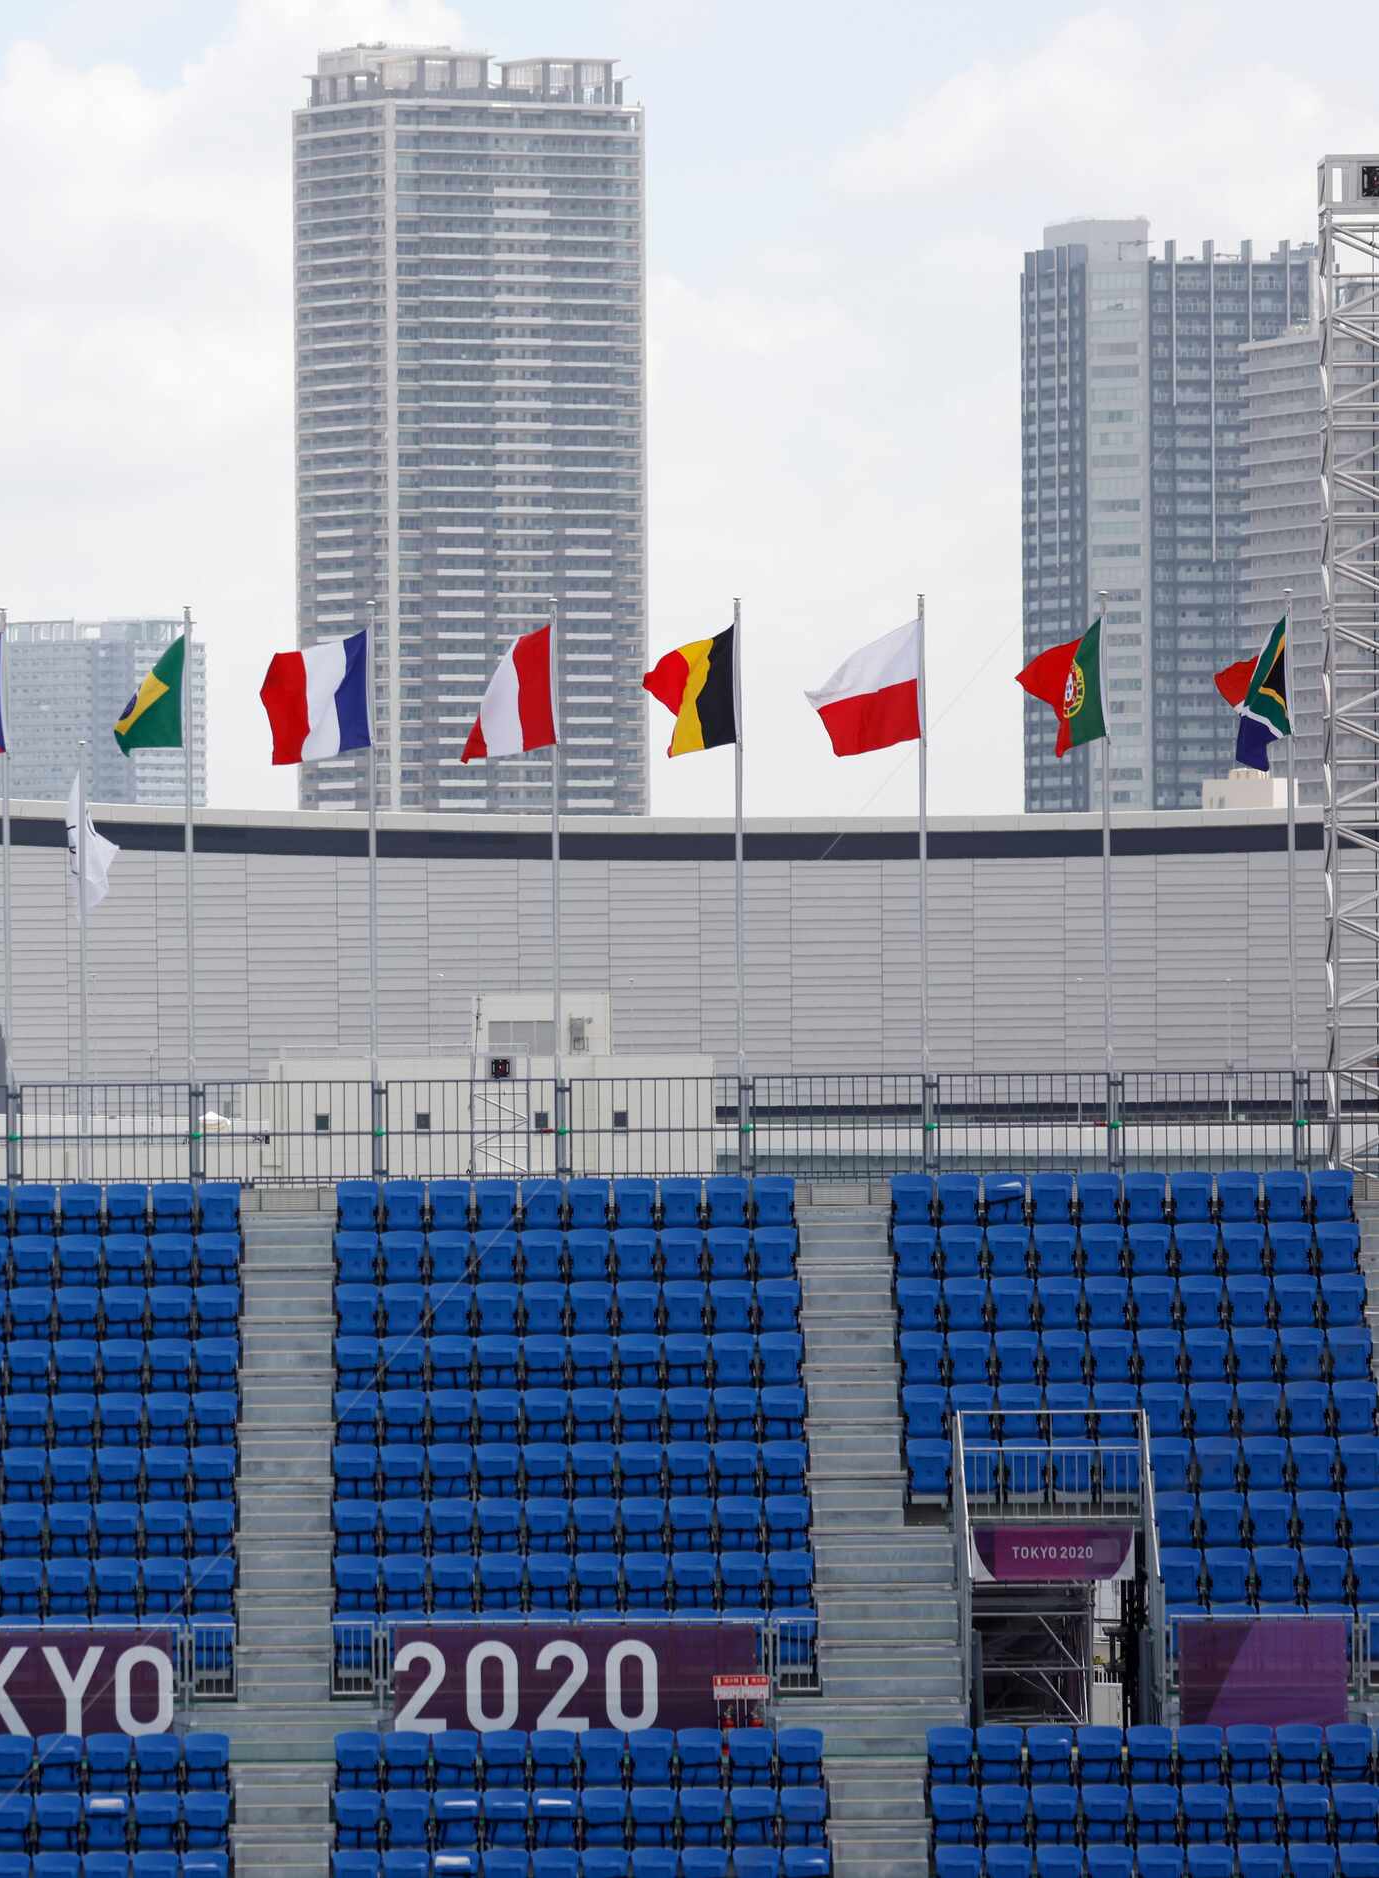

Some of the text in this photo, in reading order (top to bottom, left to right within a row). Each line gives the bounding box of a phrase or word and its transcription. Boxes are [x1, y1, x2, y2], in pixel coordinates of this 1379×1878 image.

[1012, 1545, 1094, 1560] TOKYO 2020
[393, 1639, 659, 1732] 2020
